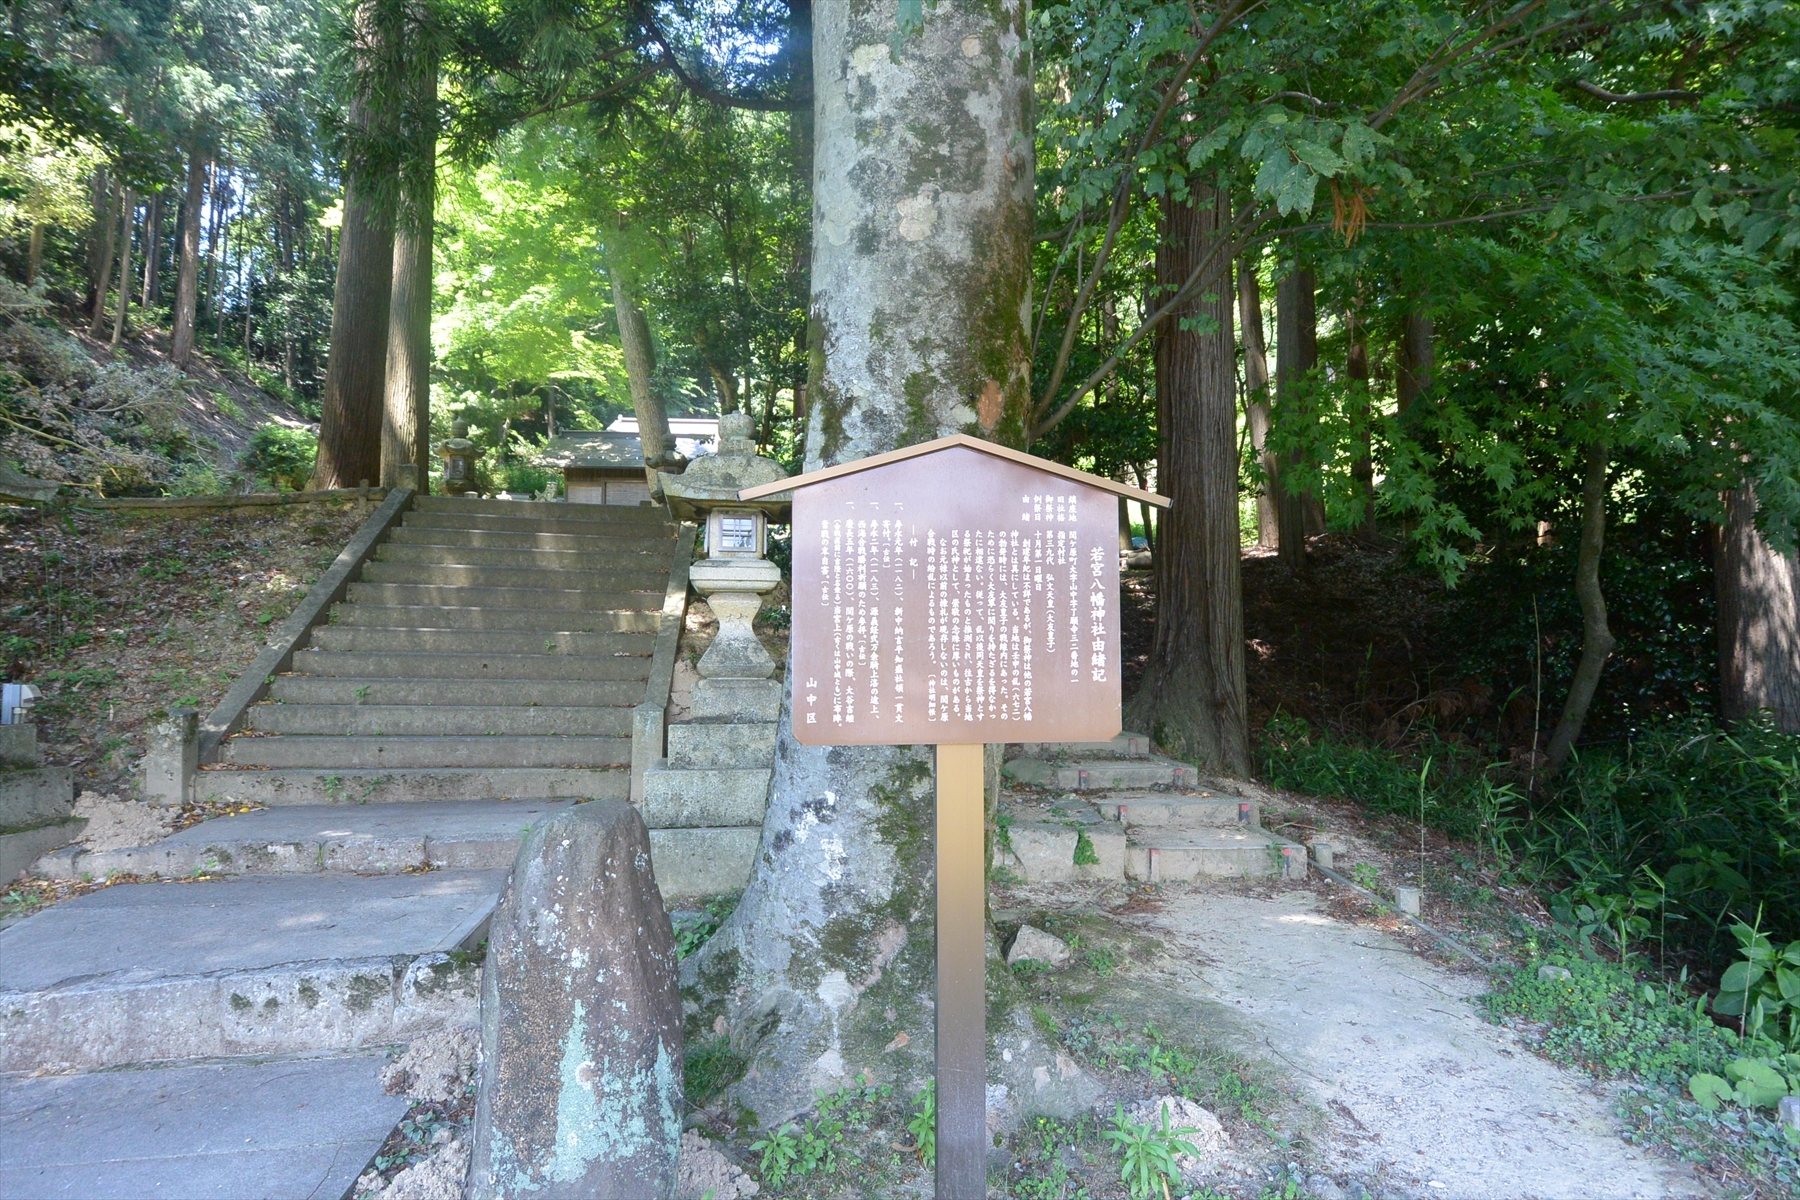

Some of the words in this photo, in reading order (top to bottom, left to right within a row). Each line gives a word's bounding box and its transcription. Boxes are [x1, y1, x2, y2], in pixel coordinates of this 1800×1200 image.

[1021, 493, 1031, 522] 由緒
[1033, 494, 1043, 522] 例祭日
[1044, 494, 1055, 522] 御祭神
[1056, 495, 1066, 522] 旧社格
[1067, 494, 1078, 522] 鎮座地
[1033, 530, 1044, 592] 十月第一日曜日
[1045, 529, 1055, 566] 第三九代
[1056, 530, 1067, 566] 指定村社
[1089, 545, 1108, 683] 若宮八幡神社由緒記
[805, 676, 818, 724] 山中区
